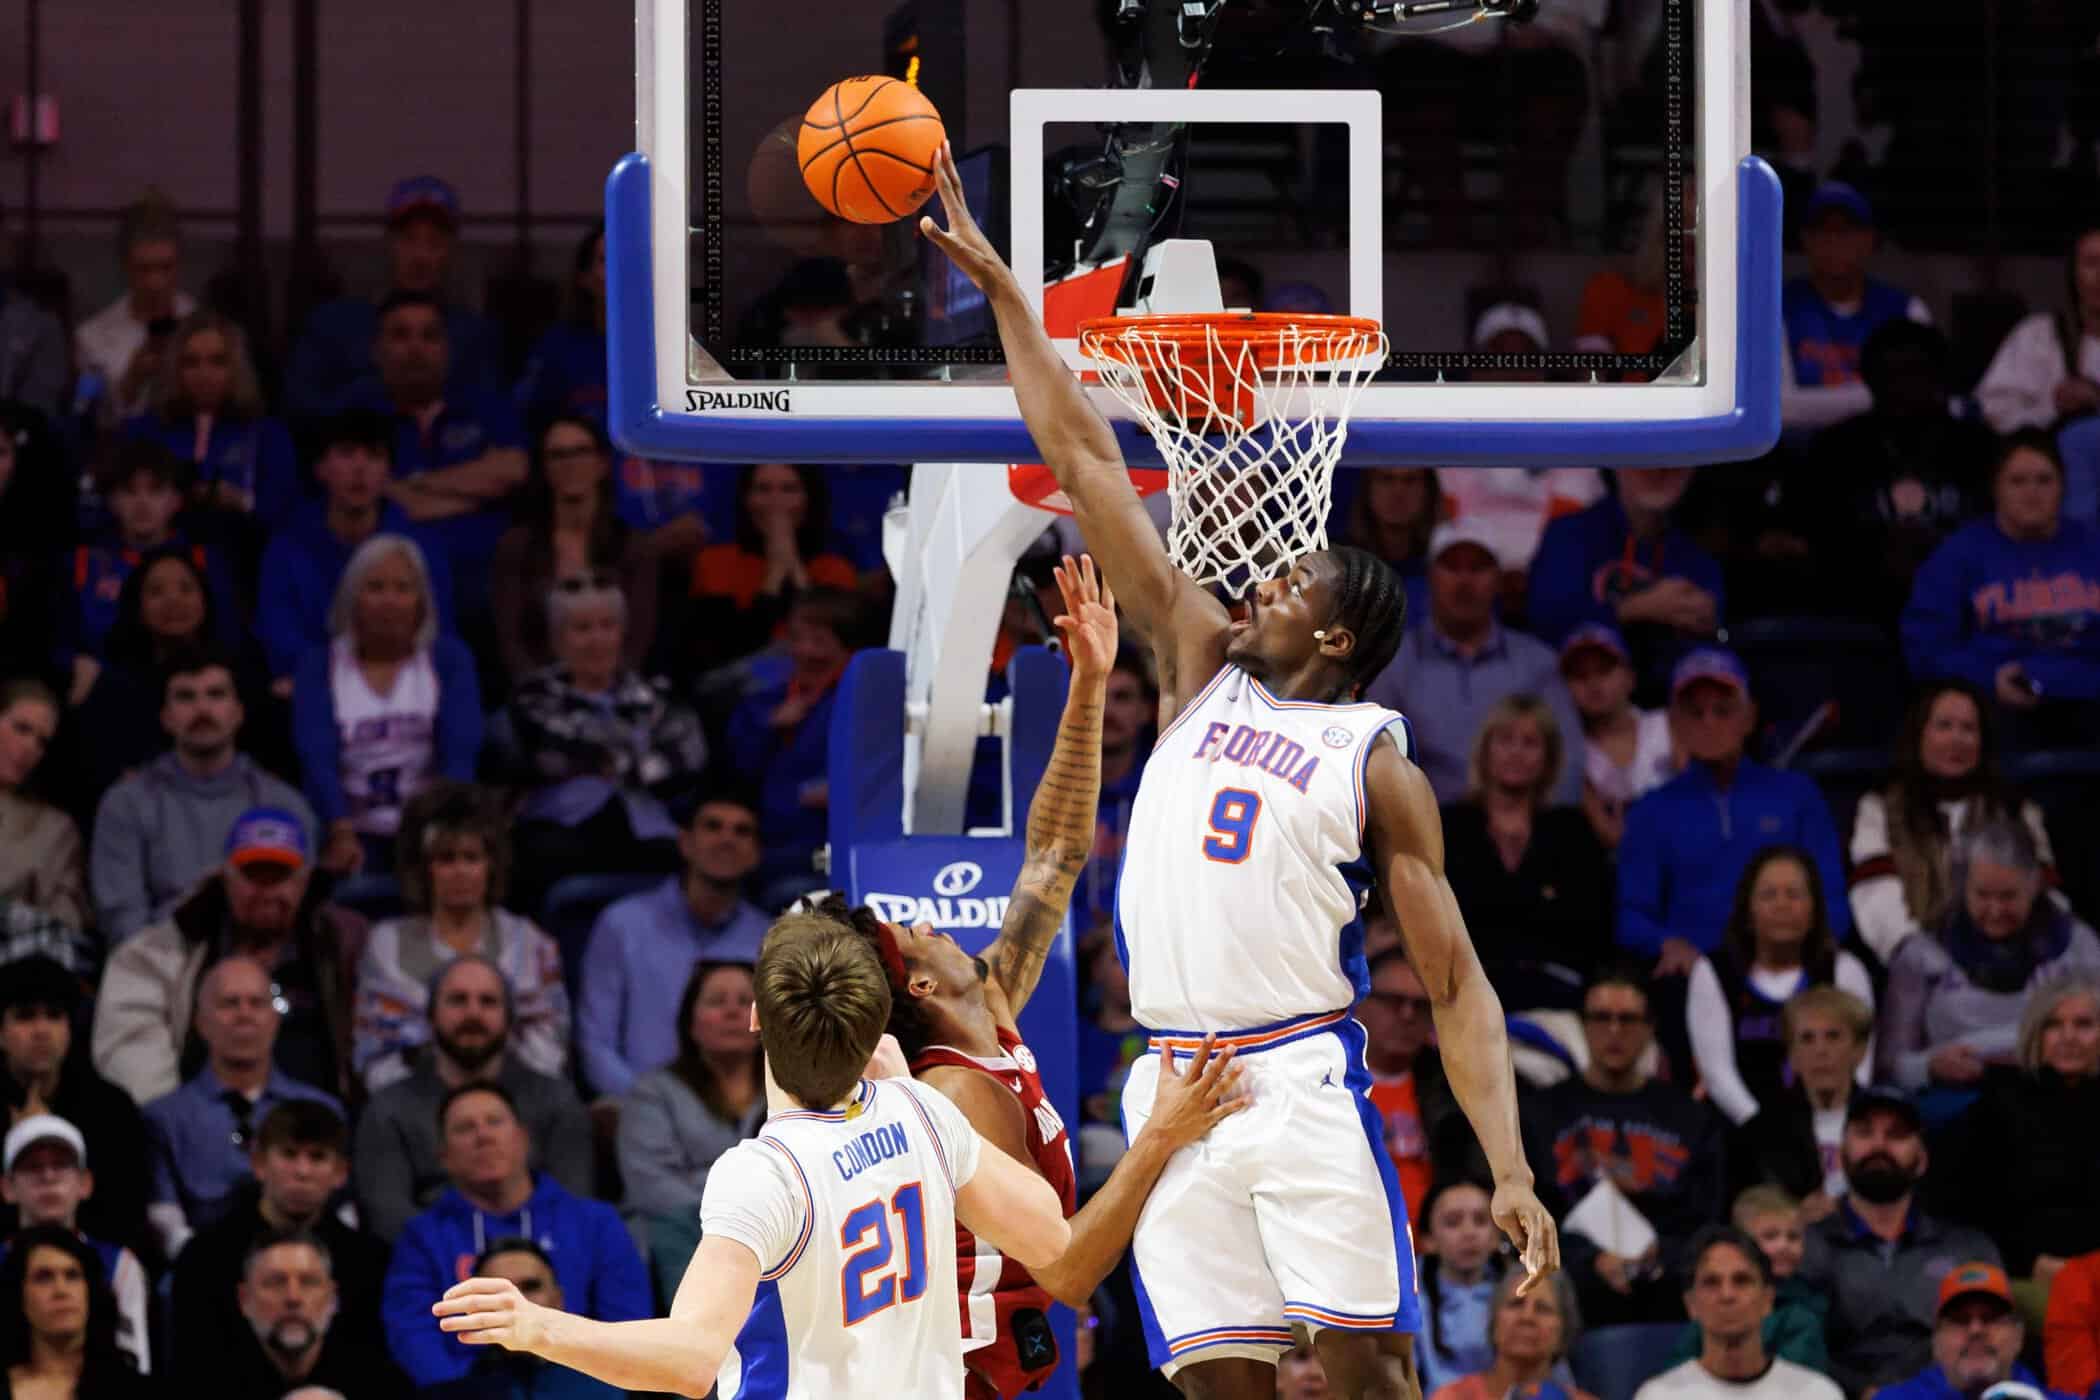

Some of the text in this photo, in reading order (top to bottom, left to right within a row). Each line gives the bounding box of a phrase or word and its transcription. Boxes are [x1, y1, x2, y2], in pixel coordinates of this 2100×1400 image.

[685, 389, 791, 413] SPALDING
[1202, 786, 1263, 865] 9
[864, 892, 1011, 929] SPALDI
[832, 1121, 909, 1182] CONDON
[840, 1180, 928, 1328] 21
